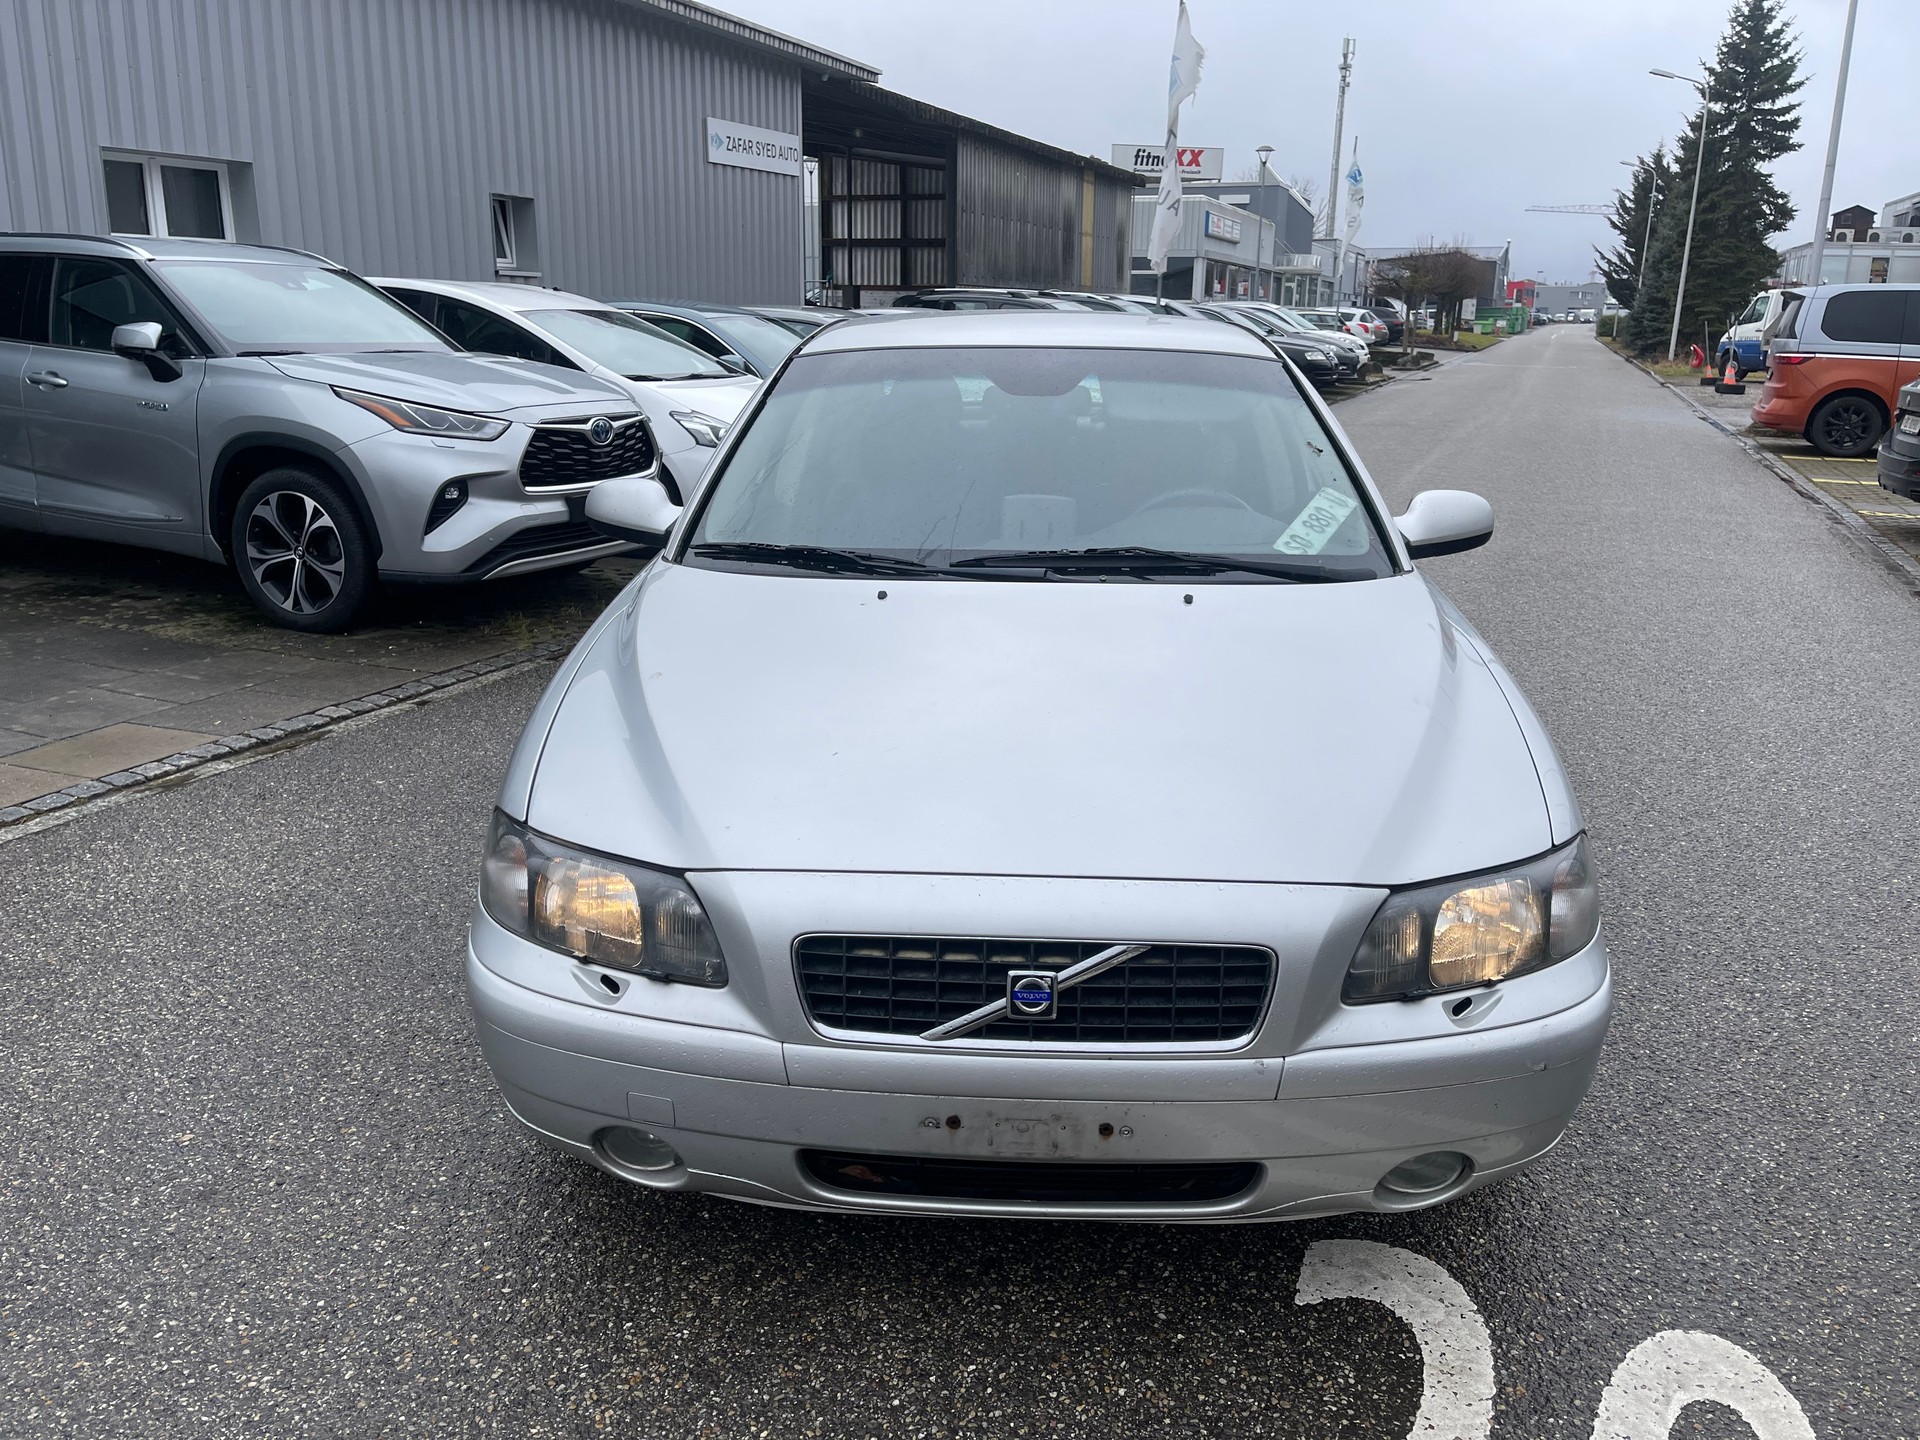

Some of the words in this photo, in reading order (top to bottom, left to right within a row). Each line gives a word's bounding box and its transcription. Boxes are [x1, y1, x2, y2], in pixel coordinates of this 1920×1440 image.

[726, 136, 754, 155] ZAFAR
[756, 141, 777, 159] SYED
[778, 145, 799, 162] AUTO
